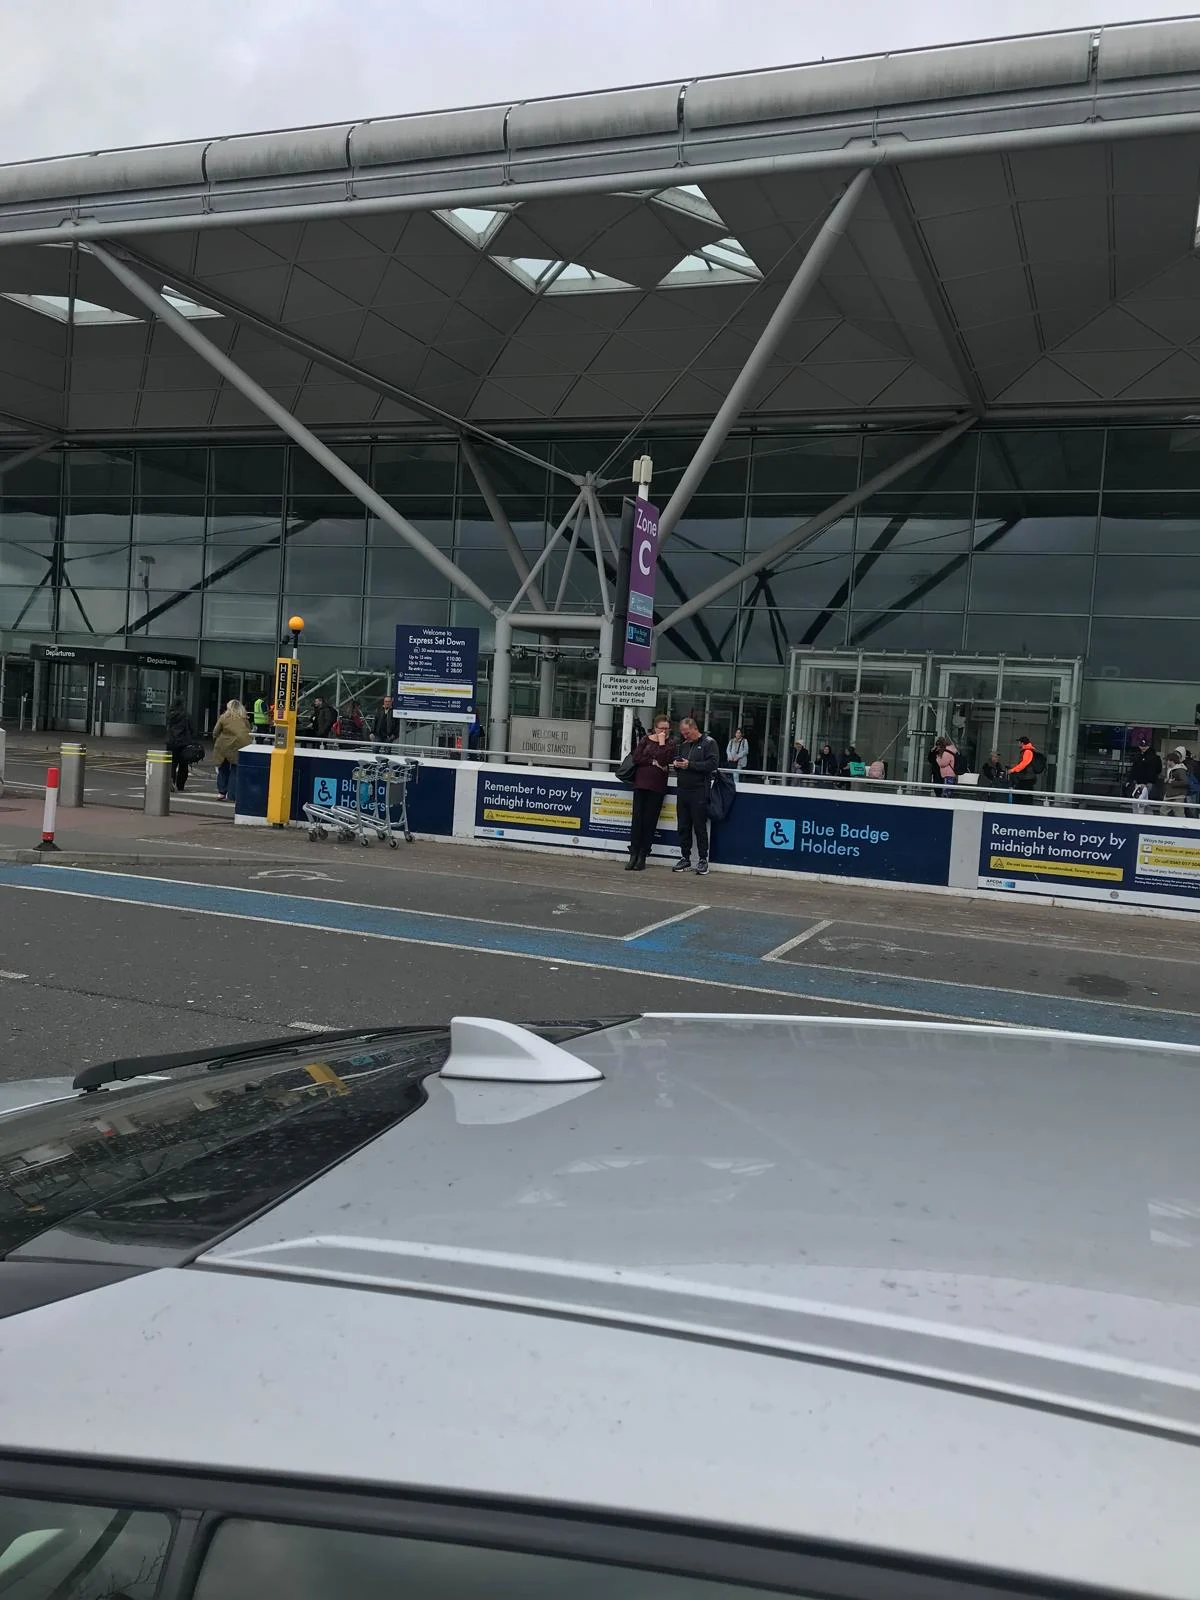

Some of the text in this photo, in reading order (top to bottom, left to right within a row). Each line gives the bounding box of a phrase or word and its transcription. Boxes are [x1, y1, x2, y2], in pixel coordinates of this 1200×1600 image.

[636, 508, 657, 537] Zone
[639, 540, 652, 576] C
[408, 636, 466, 646] Express Set Down
[146, 656, 176, 666] Departures
[278, 664, 287, 700] HELP
[532, 730, 569, 740] WELCOME TO
[522, 741, 576, 755] LONDON STANSTED
[484, 780, 583, 802] Remember to pay by
[484, 794, 572, 812] midnight tomorrow
[802, 820, 890, 844] Blue Badge
[992, 823, 1127, 850] Remember to pay by
[801, 838, 860, 856] Holders
[990, 840, 1112, 861] midnight tomorrow
